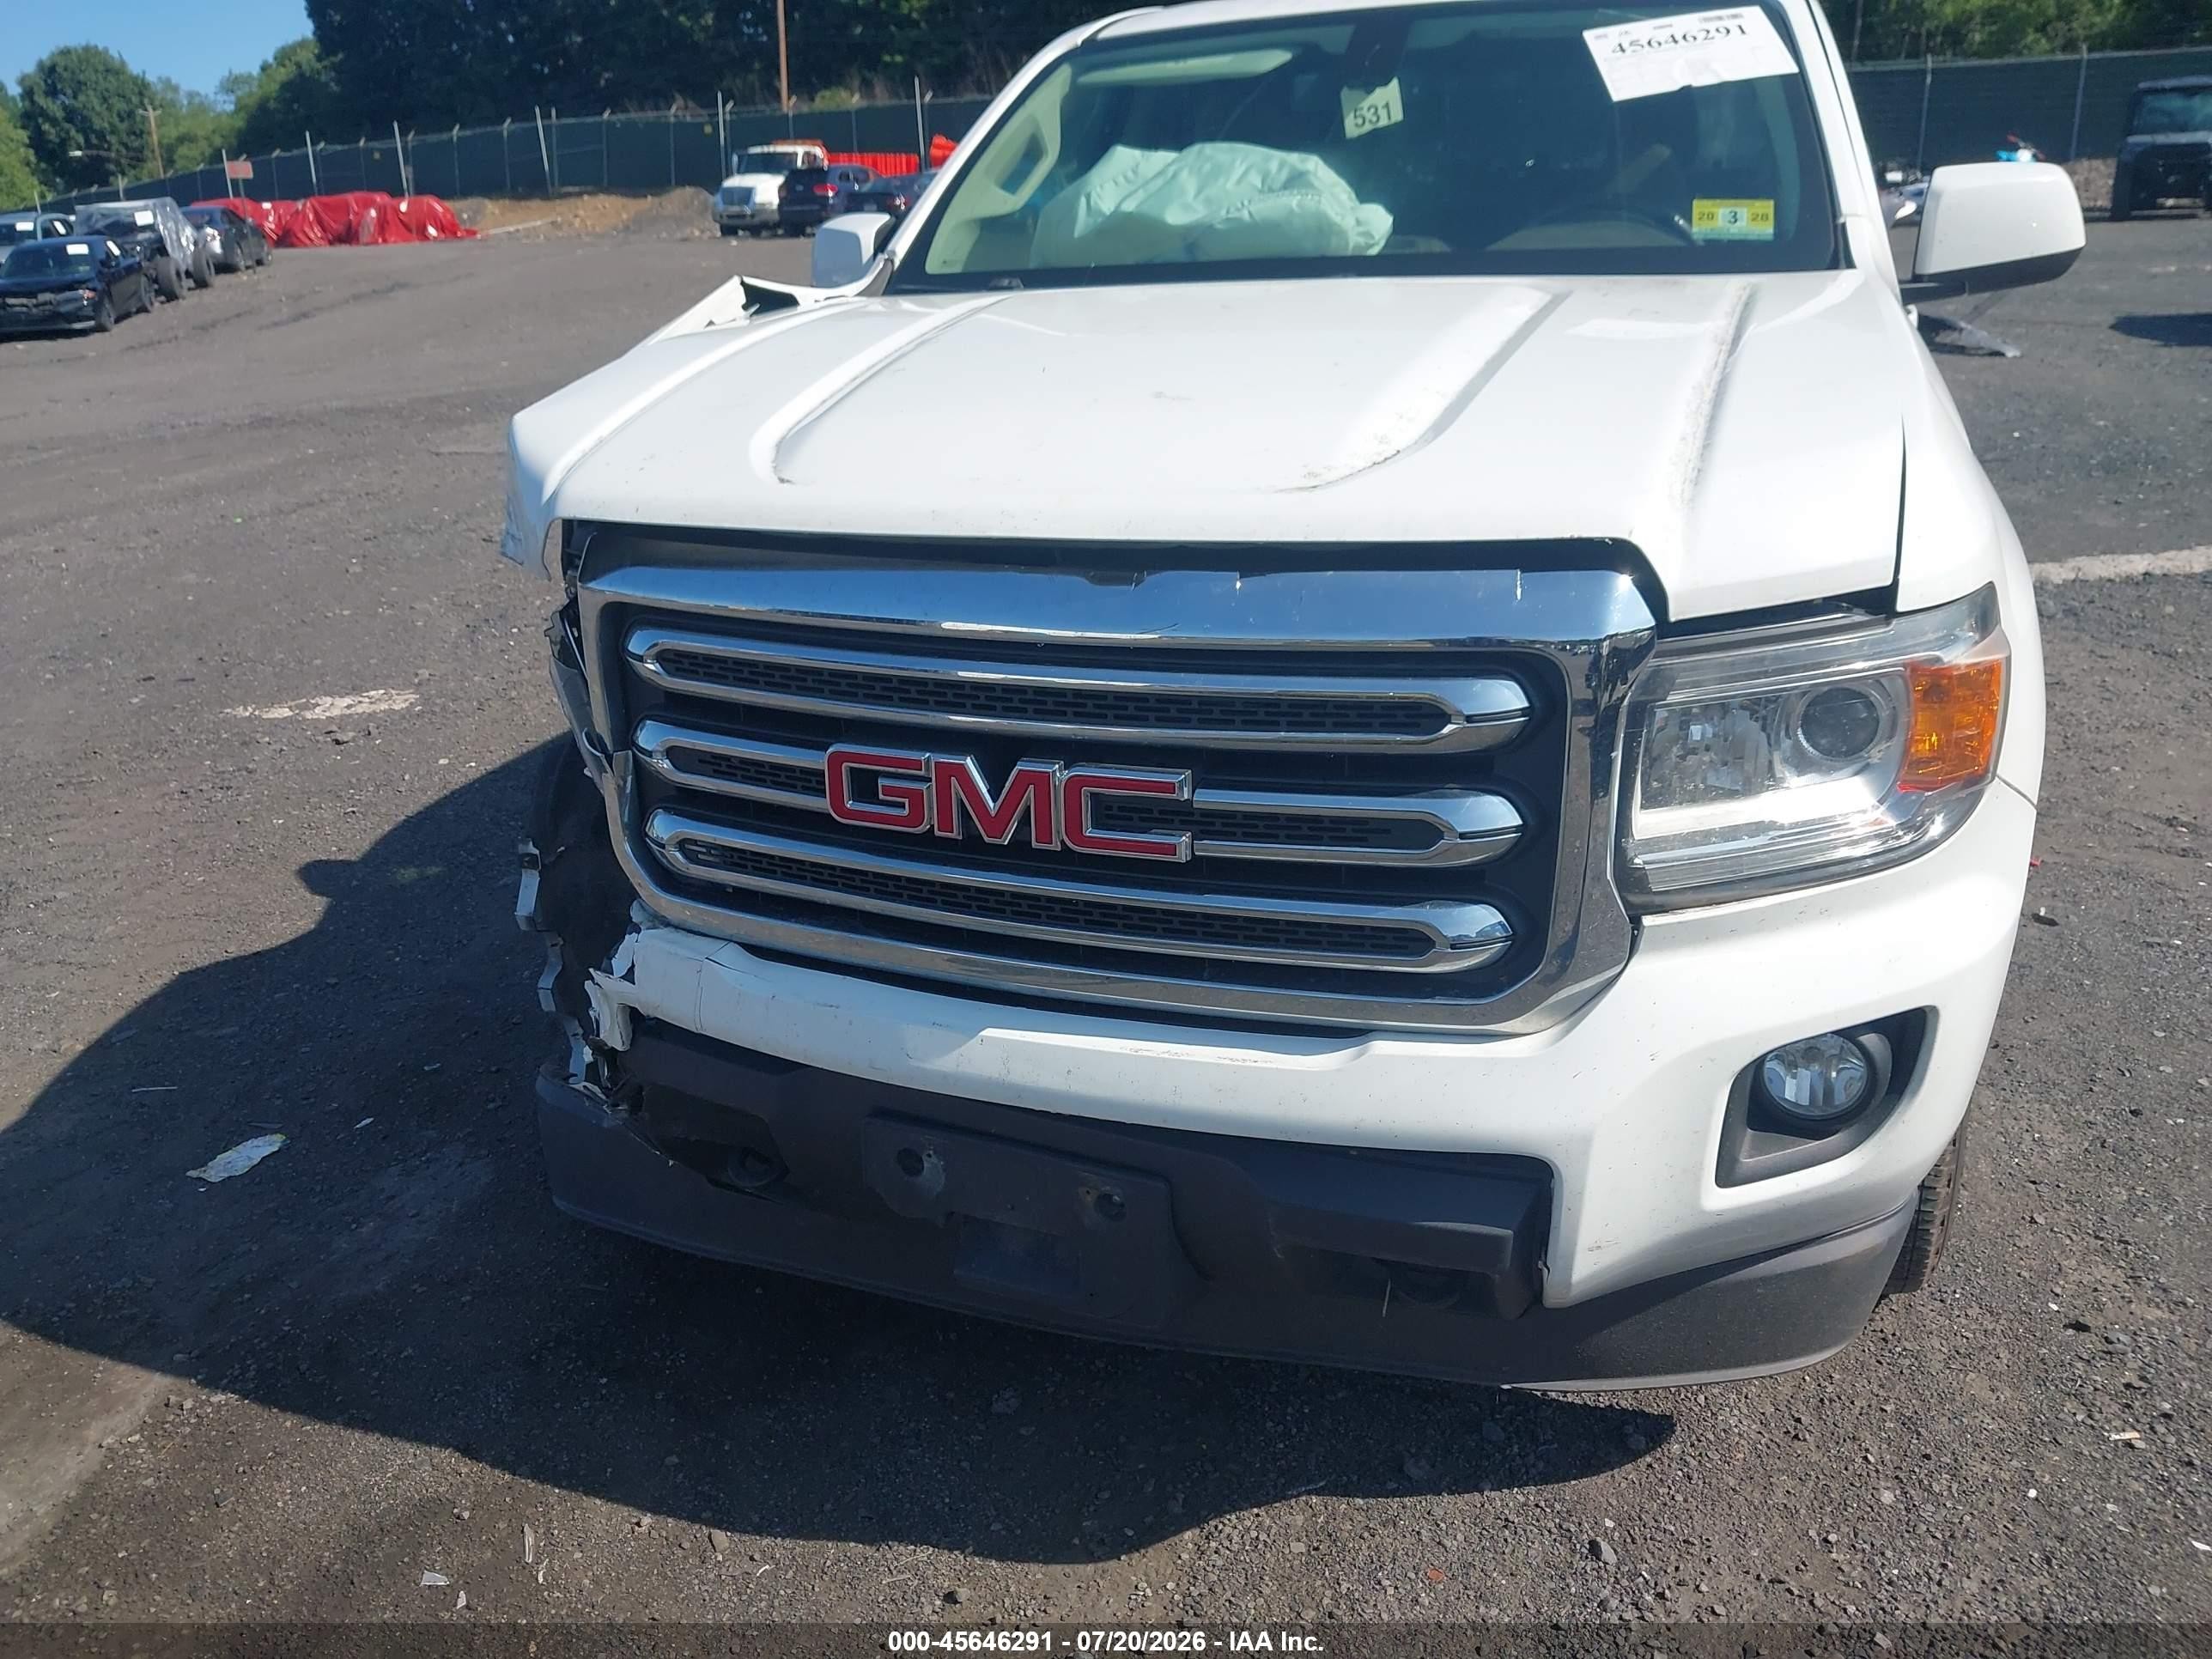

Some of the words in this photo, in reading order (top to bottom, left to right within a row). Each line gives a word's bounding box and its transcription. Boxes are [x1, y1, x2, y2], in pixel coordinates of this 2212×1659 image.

[1612, 24, 1750, 55] 45646291
[1353, 100, 1391, 128] 531
[1728, 210, 1738, 225] 3
[824, 743, 1194, 863] GMC
